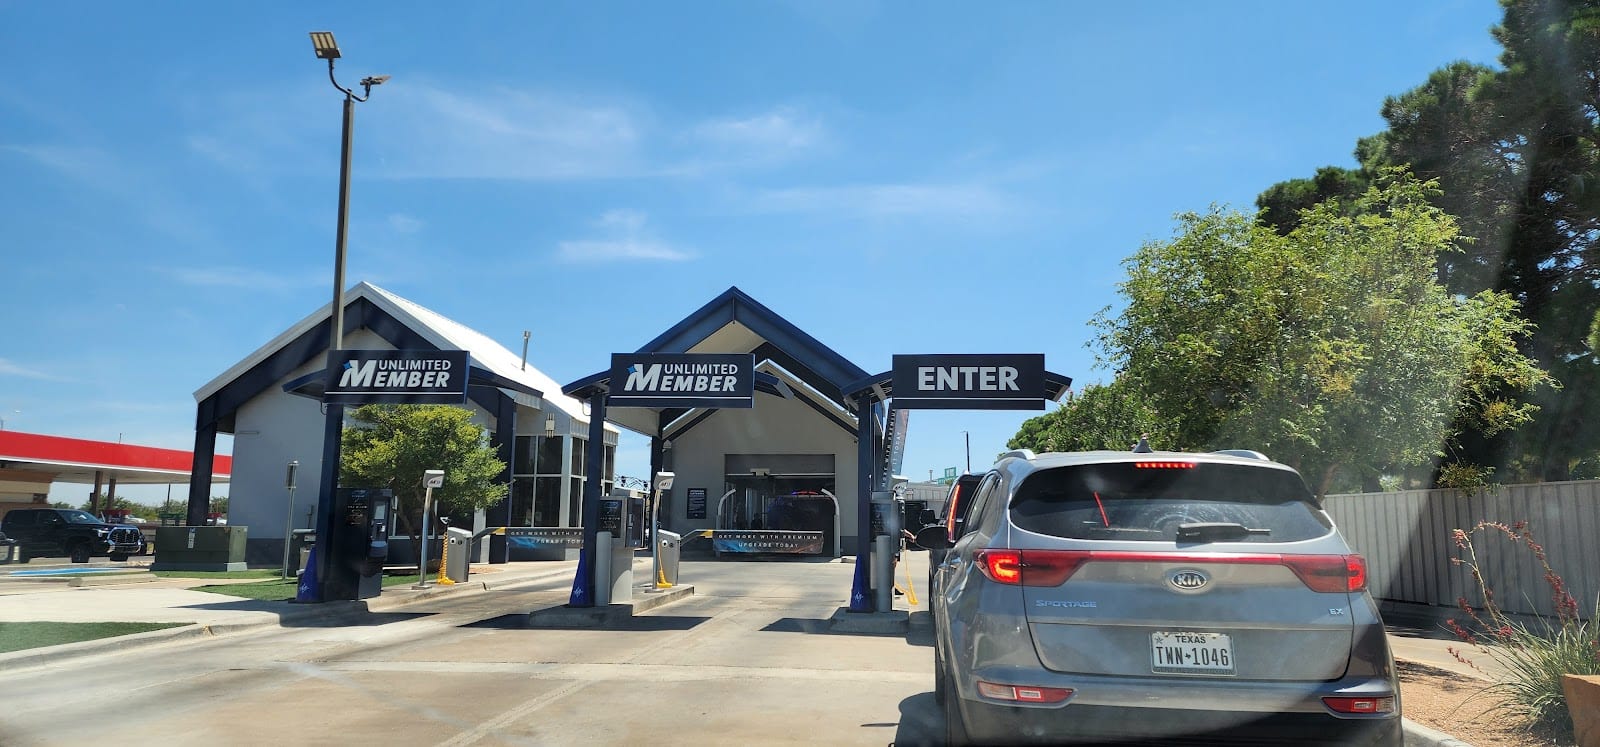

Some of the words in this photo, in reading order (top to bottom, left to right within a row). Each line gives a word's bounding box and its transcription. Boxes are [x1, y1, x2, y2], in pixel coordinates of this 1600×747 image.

[378, 359, 451, 371] UNLIMITED
[664, 363, 738, 375] UNLIMITED
[339, 359, 450, 388] MEMBER
[624, 363, 737, 392] MEMBER
[918, 366, 1020, 391] ENTER
[1177, 573, 1202, 586] KIA
[1035, 599, 1097, 609] SPORTAGE
[1329, 608, 1344, 616] EX
[1175, 635, 1206, 644] TEXAS
